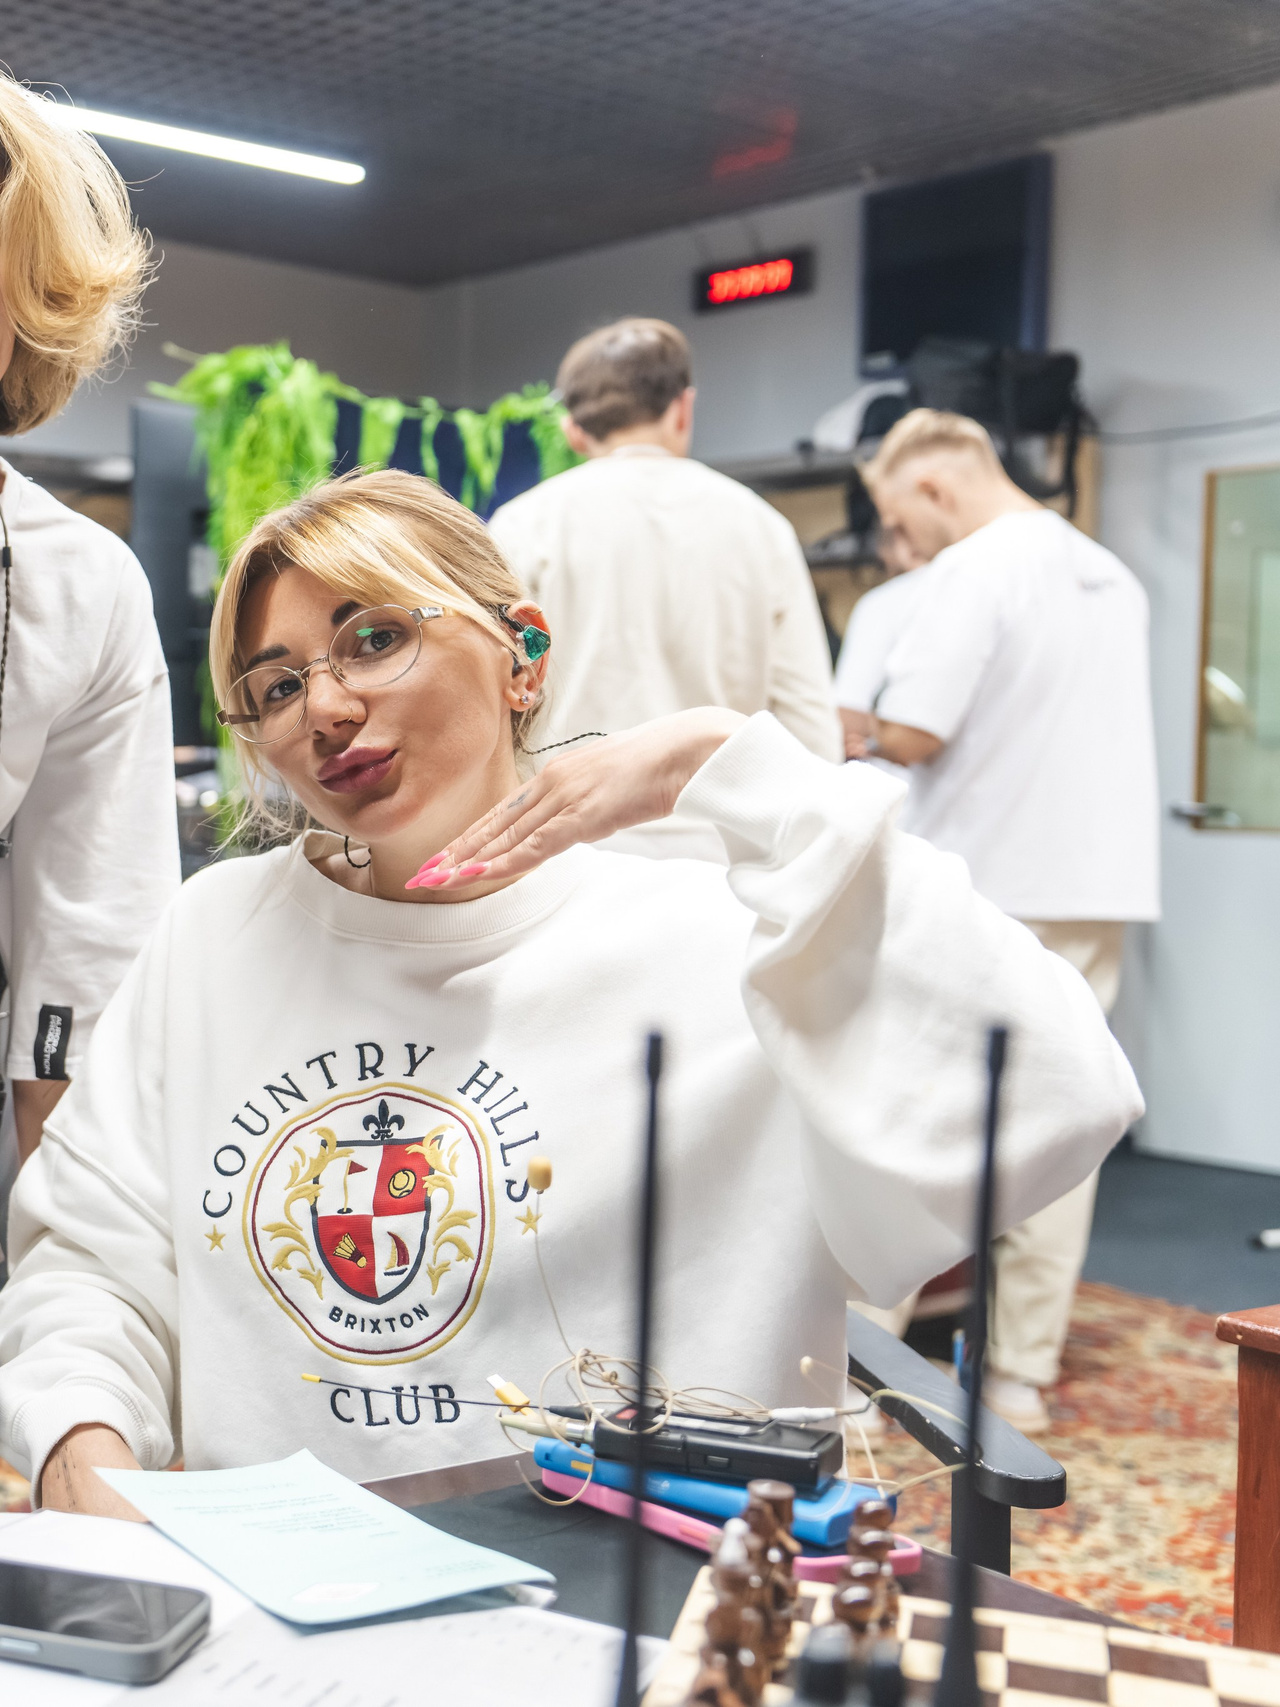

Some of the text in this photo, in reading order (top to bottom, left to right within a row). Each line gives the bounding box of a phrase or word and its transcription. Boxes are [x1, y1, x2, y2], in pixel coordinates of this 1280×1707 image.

[44, 1014, 57, 1075] PRODUCTION
[202, 1041, 540, 1219] COUNTRY HILLS
[328, 1303, 430, 1335] BRIXTON
[330, 1383, 461, 1427] CLUB
